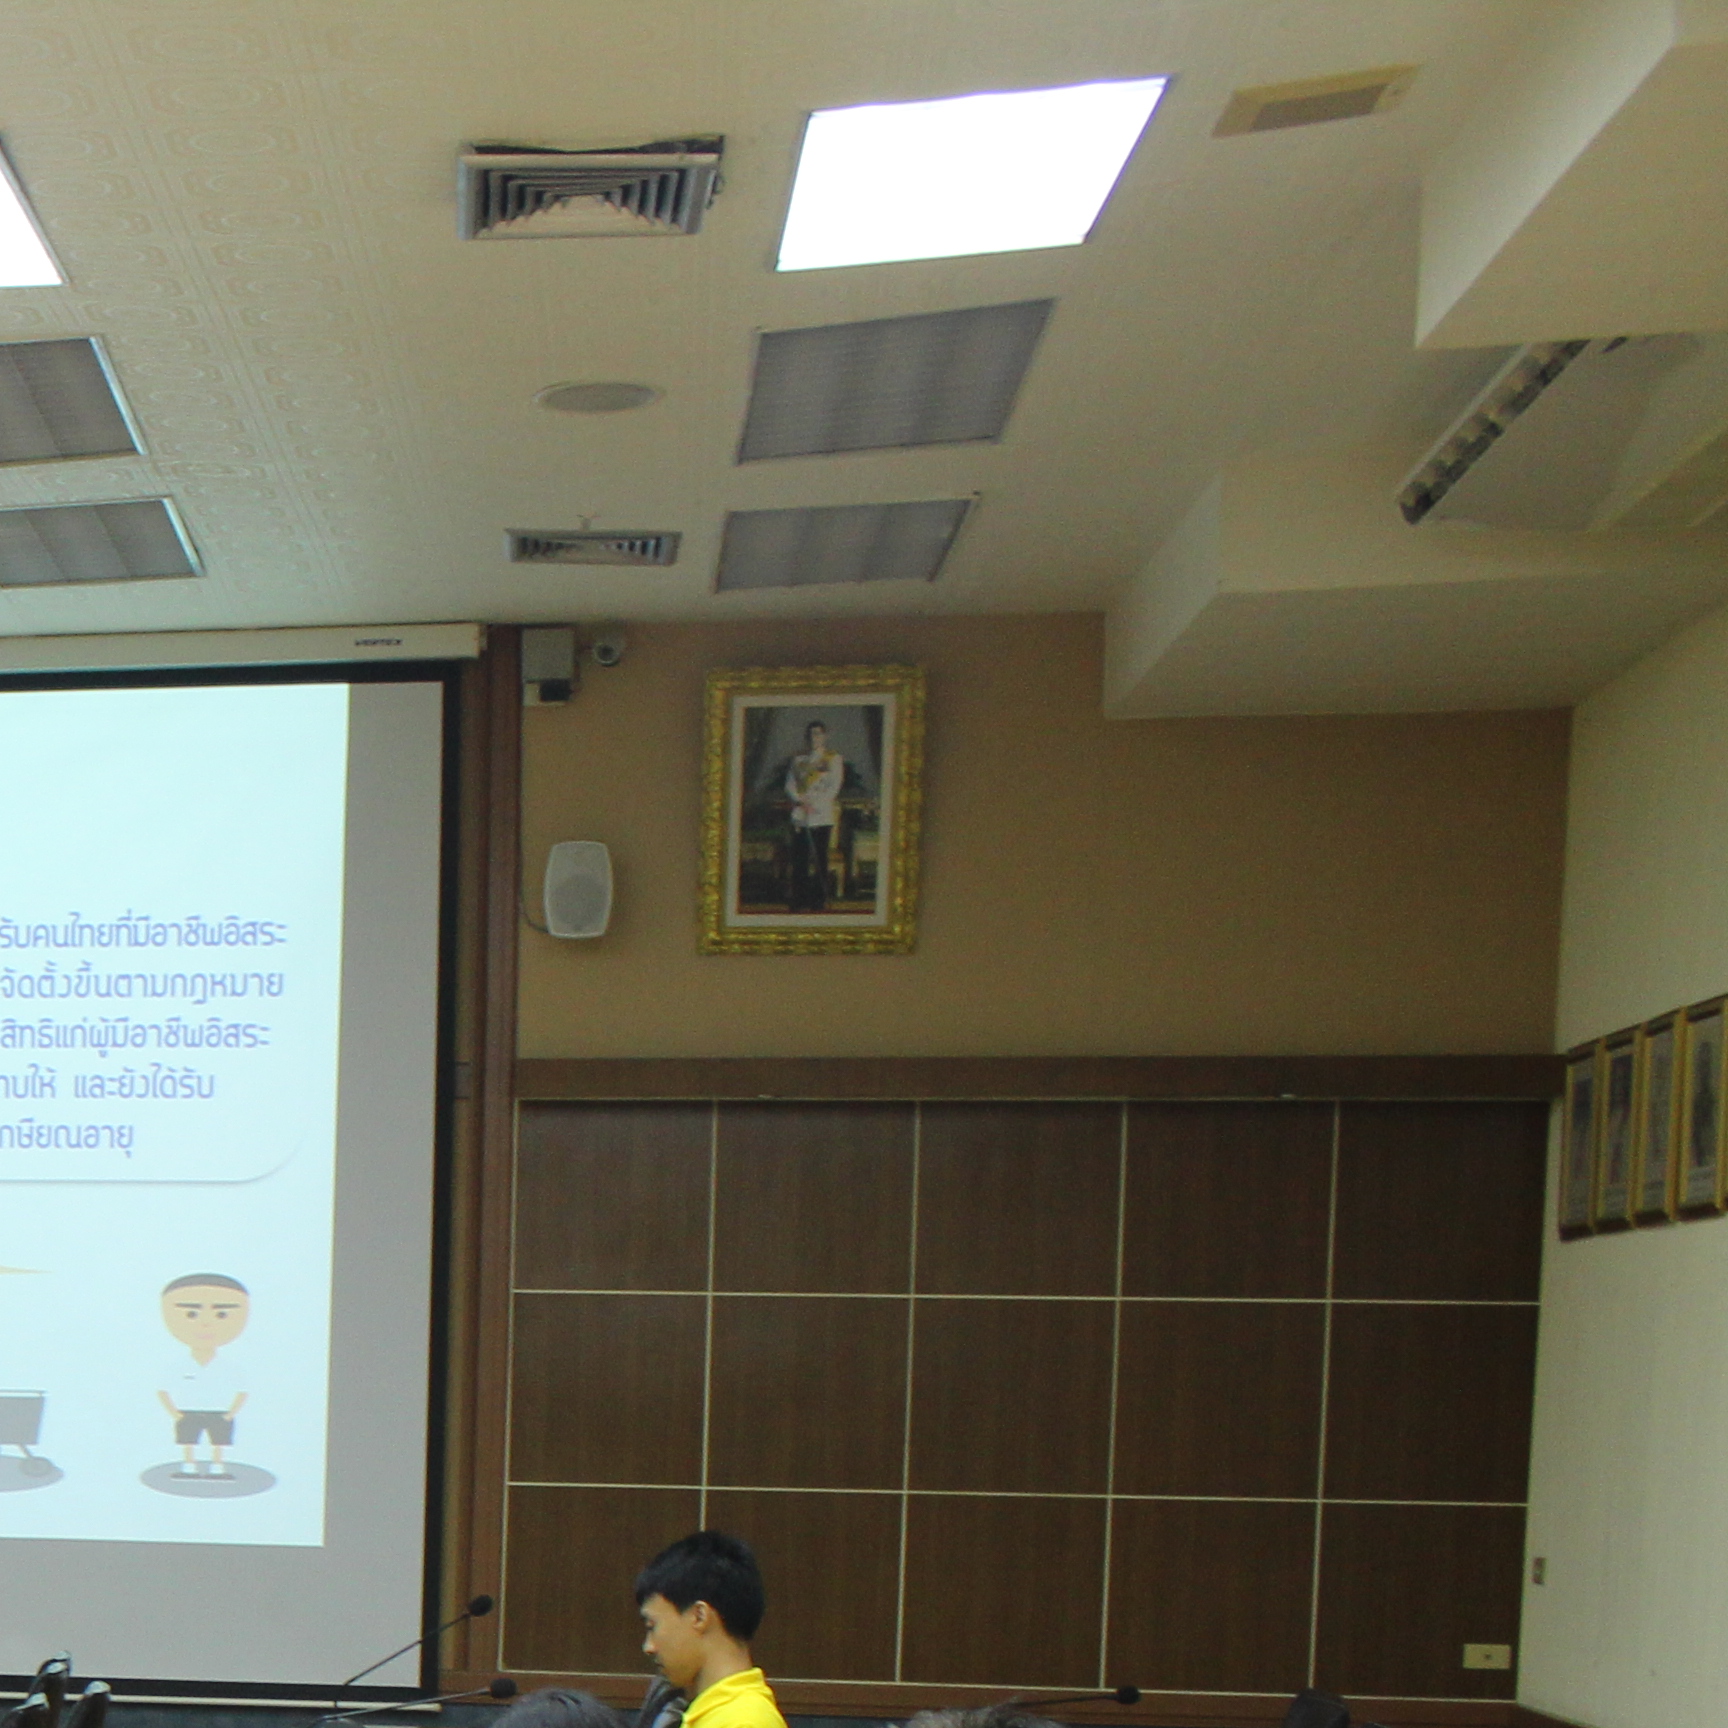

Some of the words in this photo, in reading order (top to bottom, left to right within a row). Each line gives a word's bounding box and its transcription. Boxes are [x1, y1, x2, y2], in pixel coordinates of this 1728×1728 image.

[75, 1062, 214, 1098] และยังได้รับ
